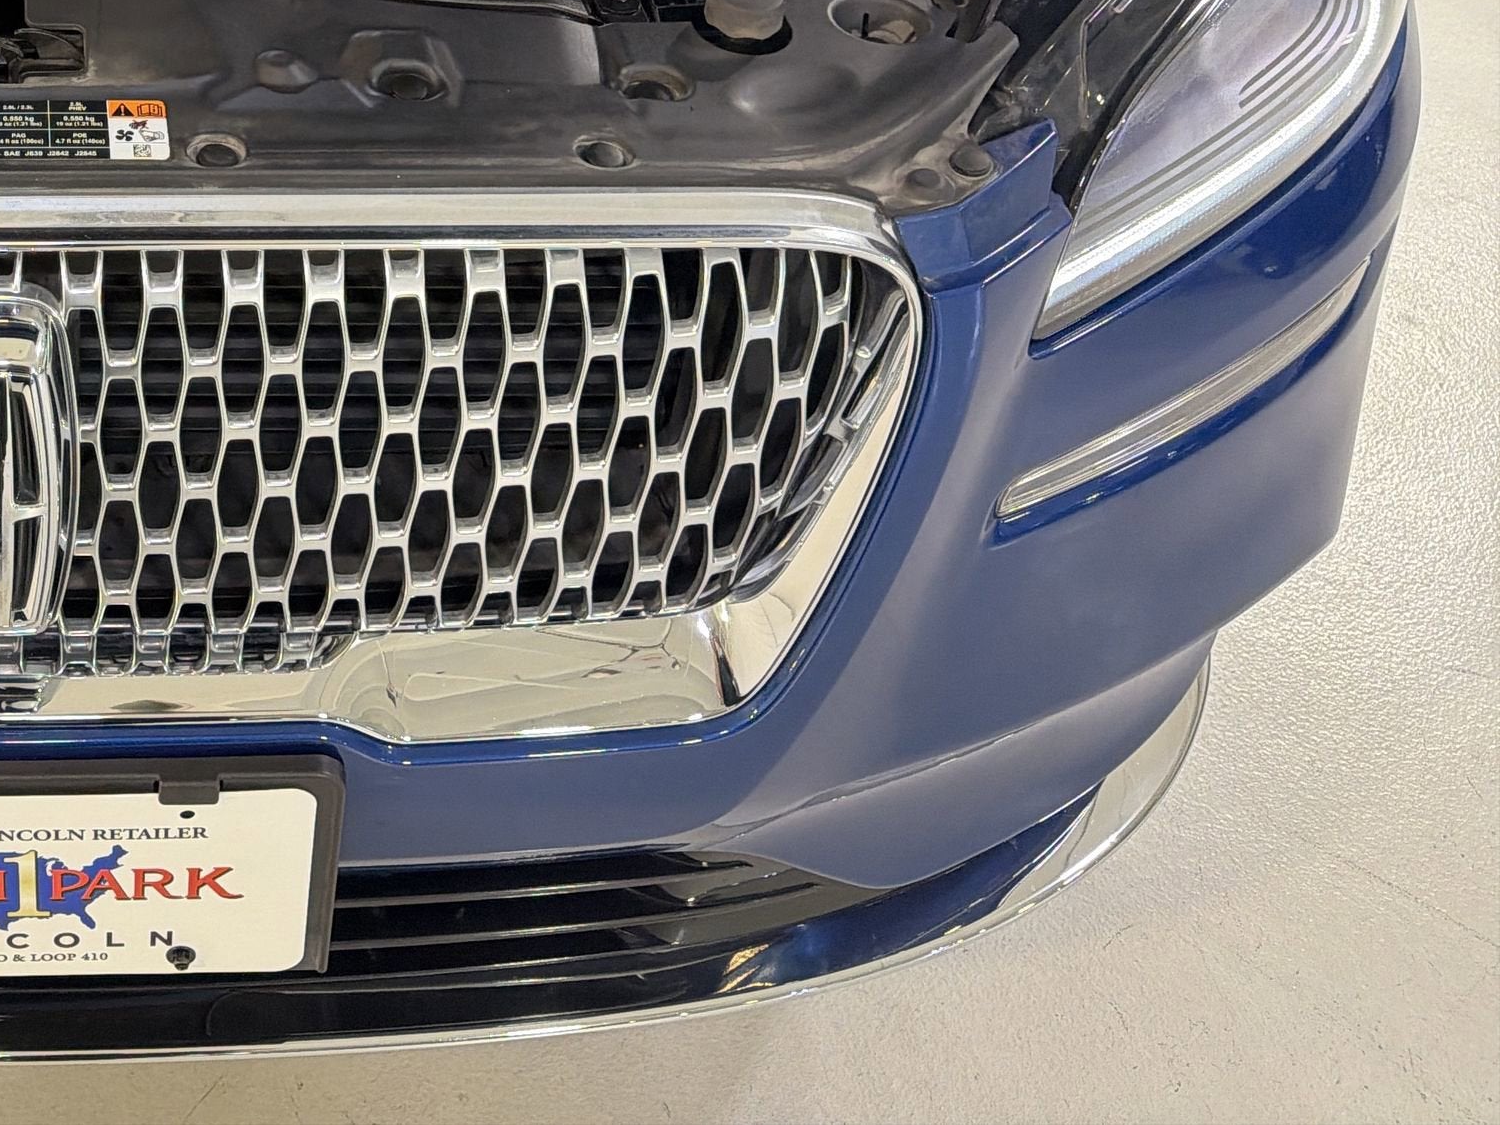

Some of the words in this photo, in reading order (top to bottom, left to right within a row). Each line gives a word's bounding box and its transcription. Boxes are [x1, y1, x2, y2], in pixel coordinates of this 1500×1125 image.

[84, 115, 95, 123] kg
[92, 827, 209, 841] RETAILER
[49, 866, 245, 902] PARK
[12, 953, 26, 963] &
[30, 952, 77, 962] LOOP
[80, 951, 109, 962] 410
